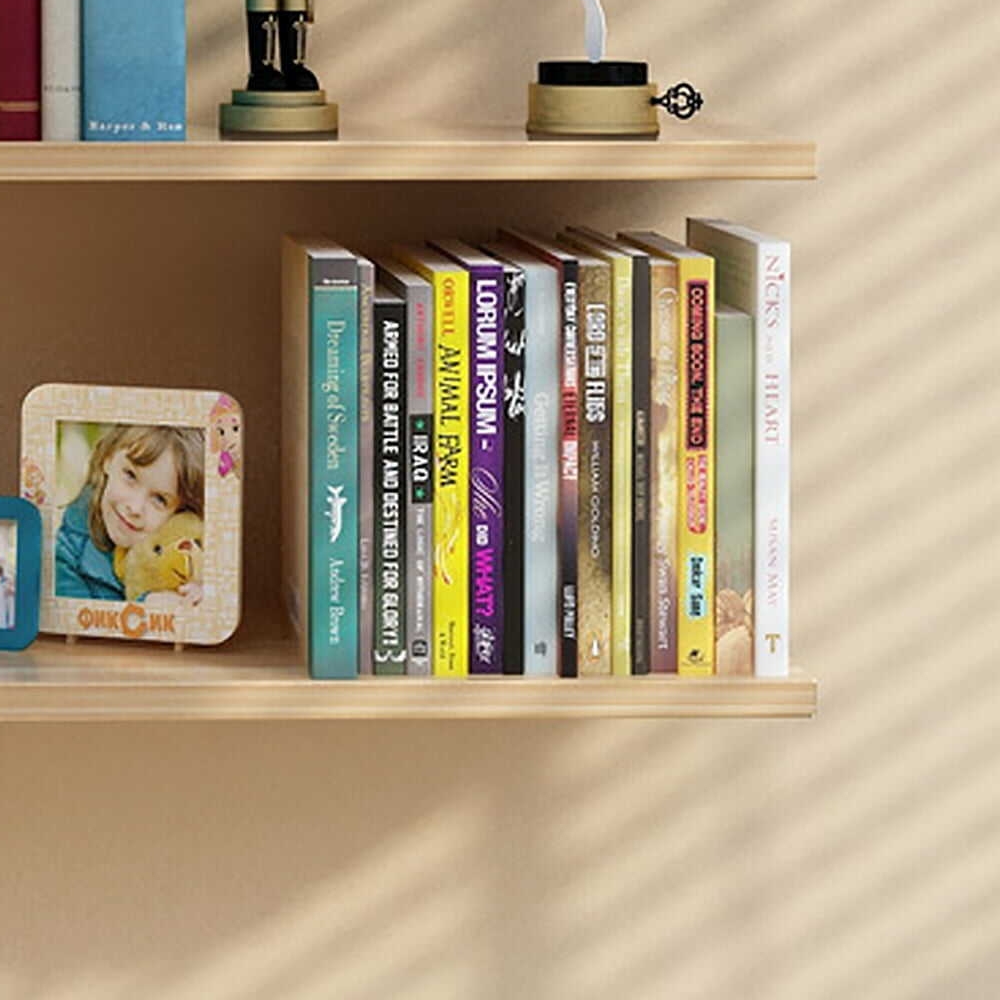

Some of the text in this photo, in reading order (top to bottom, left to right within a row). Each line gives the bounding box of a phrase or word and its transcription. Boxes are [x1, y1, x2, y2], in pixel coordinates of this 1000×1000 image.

[442, 277, 455, 335] ORWELL
[476, 280, 497, 359] LORUM
[322, 321, 346, 470] Dreaming of Sweden
[438, 344, 461, 487] ANIMAL FARM
[476, 363, 497, 434] IPSUM
[585, 381, 606, 422] FLIES
[765, 373, 779, 443] HEART
[413, 434, 429, 482] IRAQ
[690, 416, 705, 446] END
[383, 320, 400, 645] ARMED FOR BATTLE AND DESTINED FOR GLORY!
[532, 480, 549, 543] Wrong
[590, 440, 601, 558] WILLIAM GOLDING
[476, 524, 489, 546] DID
[329, 557, 345, 645] Andrew Brown
[475, 548, 495, 617] WHAT?
